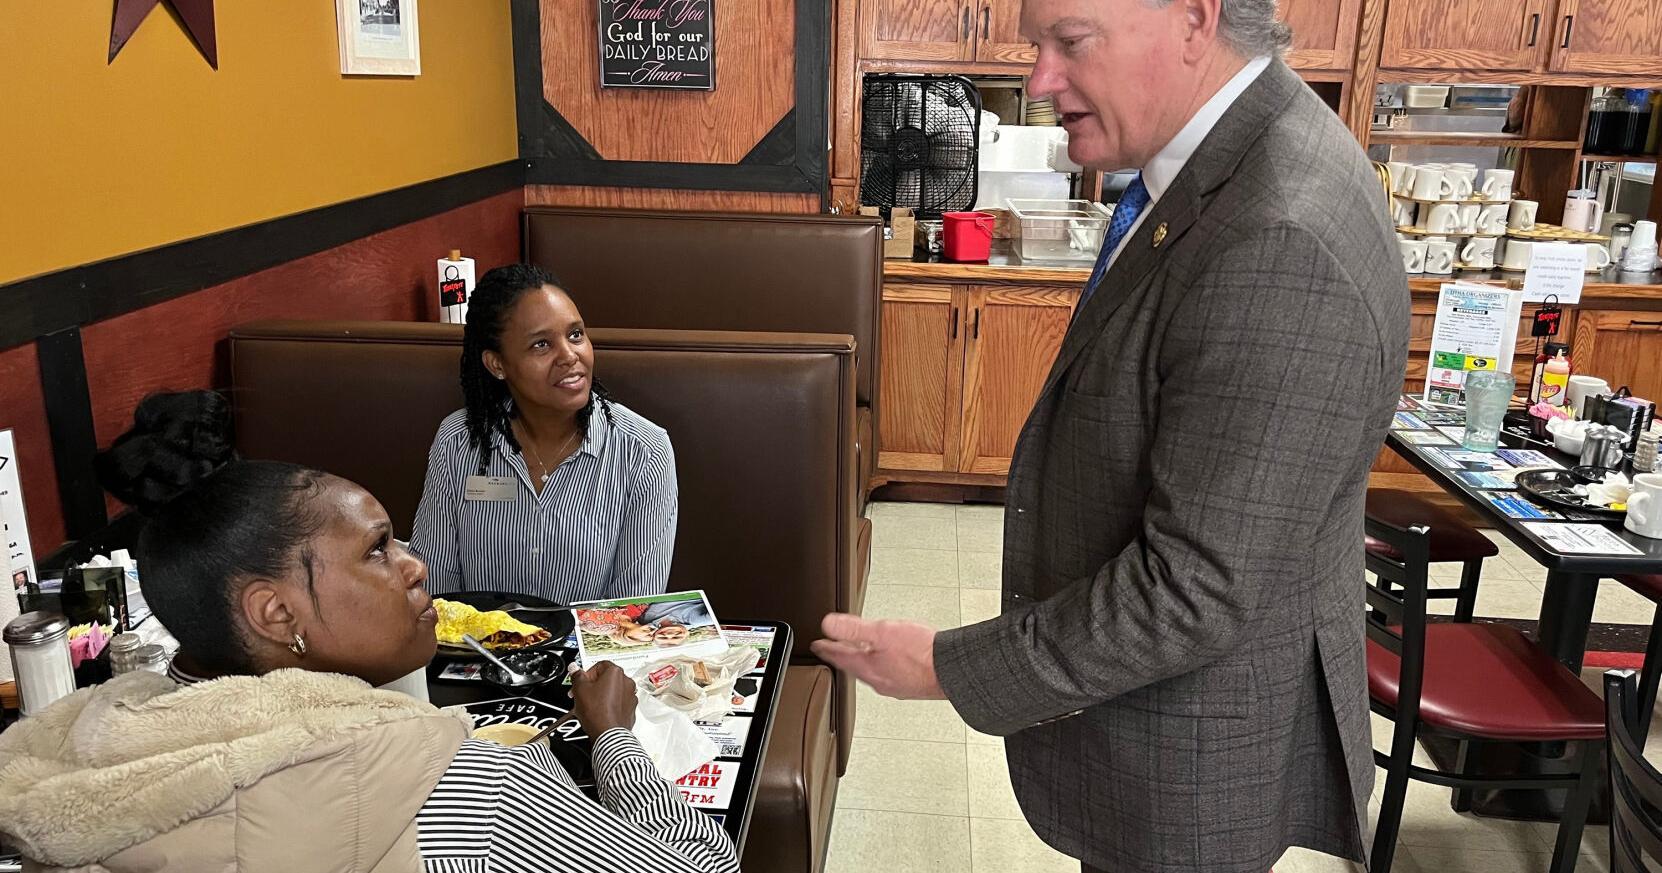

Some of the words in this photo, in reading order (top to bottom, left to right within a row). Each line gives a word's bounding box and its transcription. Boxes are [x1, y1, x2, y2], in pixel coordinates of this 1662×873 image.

[613, 0, 666, 21] Thank
[666, 0, 705, 28] You
[607, 21, 643, 42] God
[651, 21, 671, 48] for
[679, 33, 703, 42] our
[605, 44, 651, 59] DAILY
[656, 45, 709, 61] BREAD
[630, 60, 683, 84] Amen
[690, 763, 722, 775] AL
